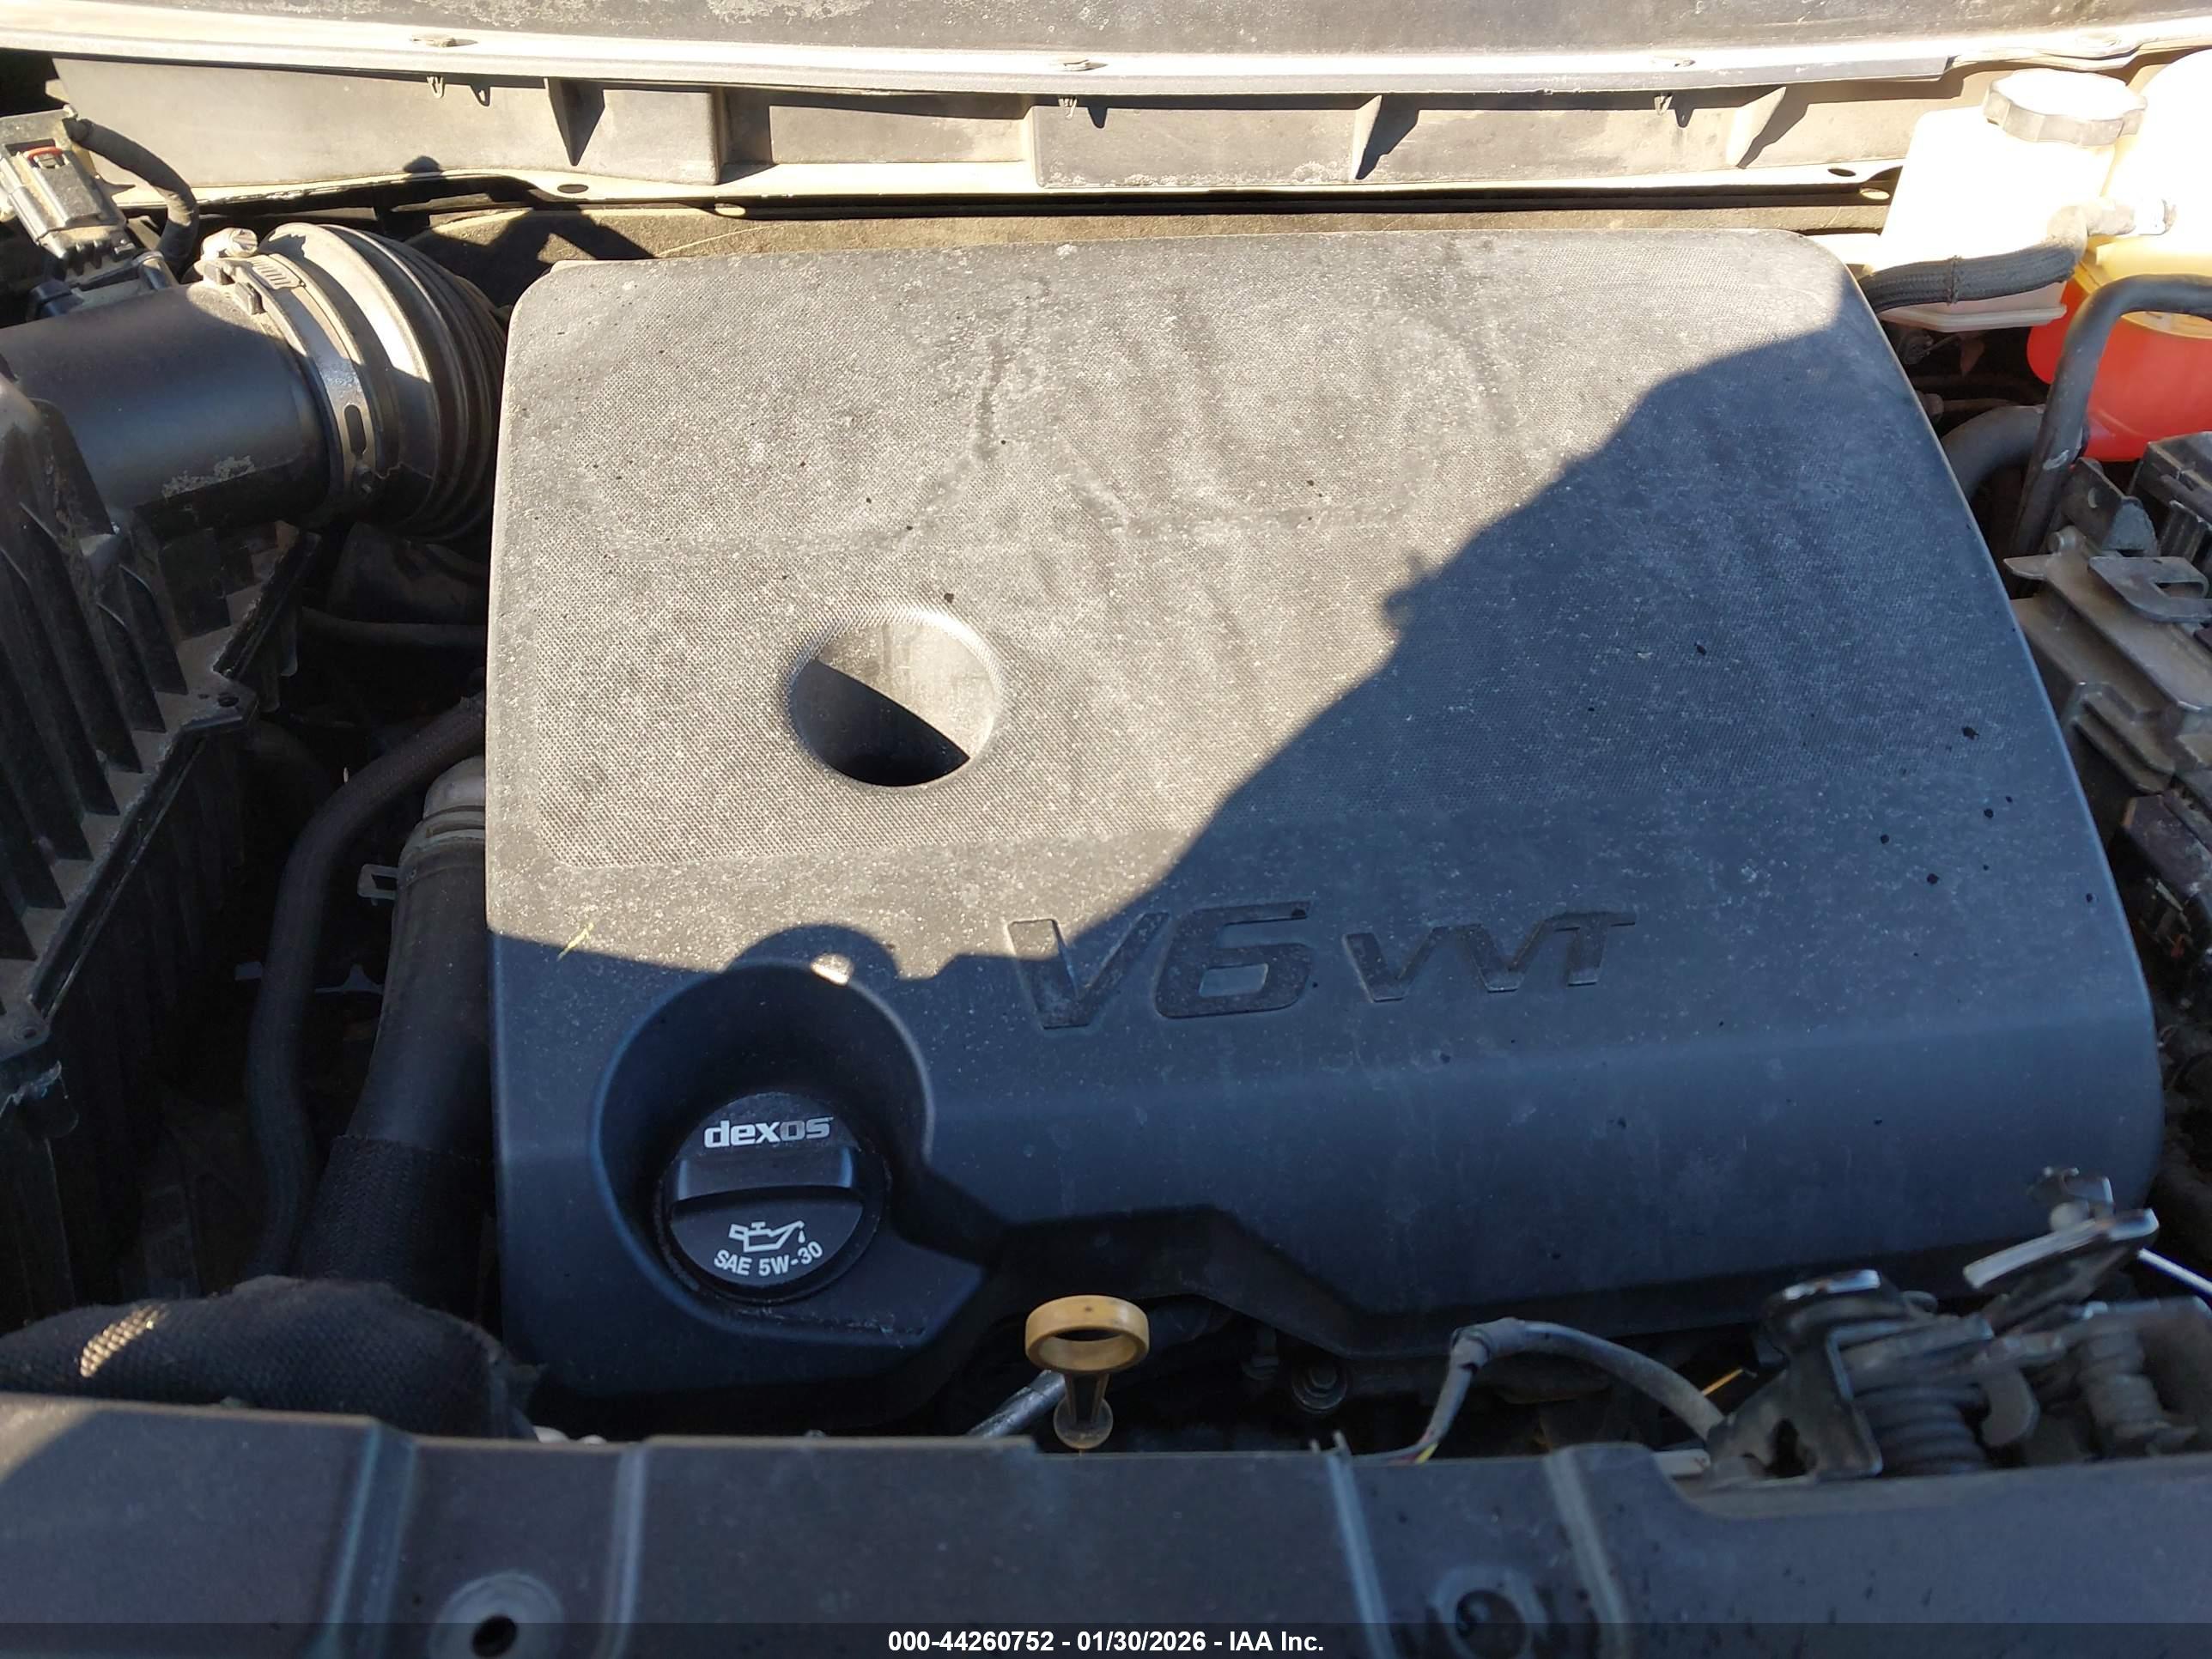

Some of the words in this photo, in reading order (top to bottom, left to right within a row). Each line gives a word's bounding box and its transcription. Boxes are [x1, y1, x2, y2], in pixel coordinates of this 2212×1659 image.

[1008, 901, 1313, 1030] V6
[1343, 910, 1637, 1003] VVT
[704, 1117, 834, 1148] dexos
[714, 1249, 752, 1276] SAE
[758, 1241, 823, 1277] 5W-30
